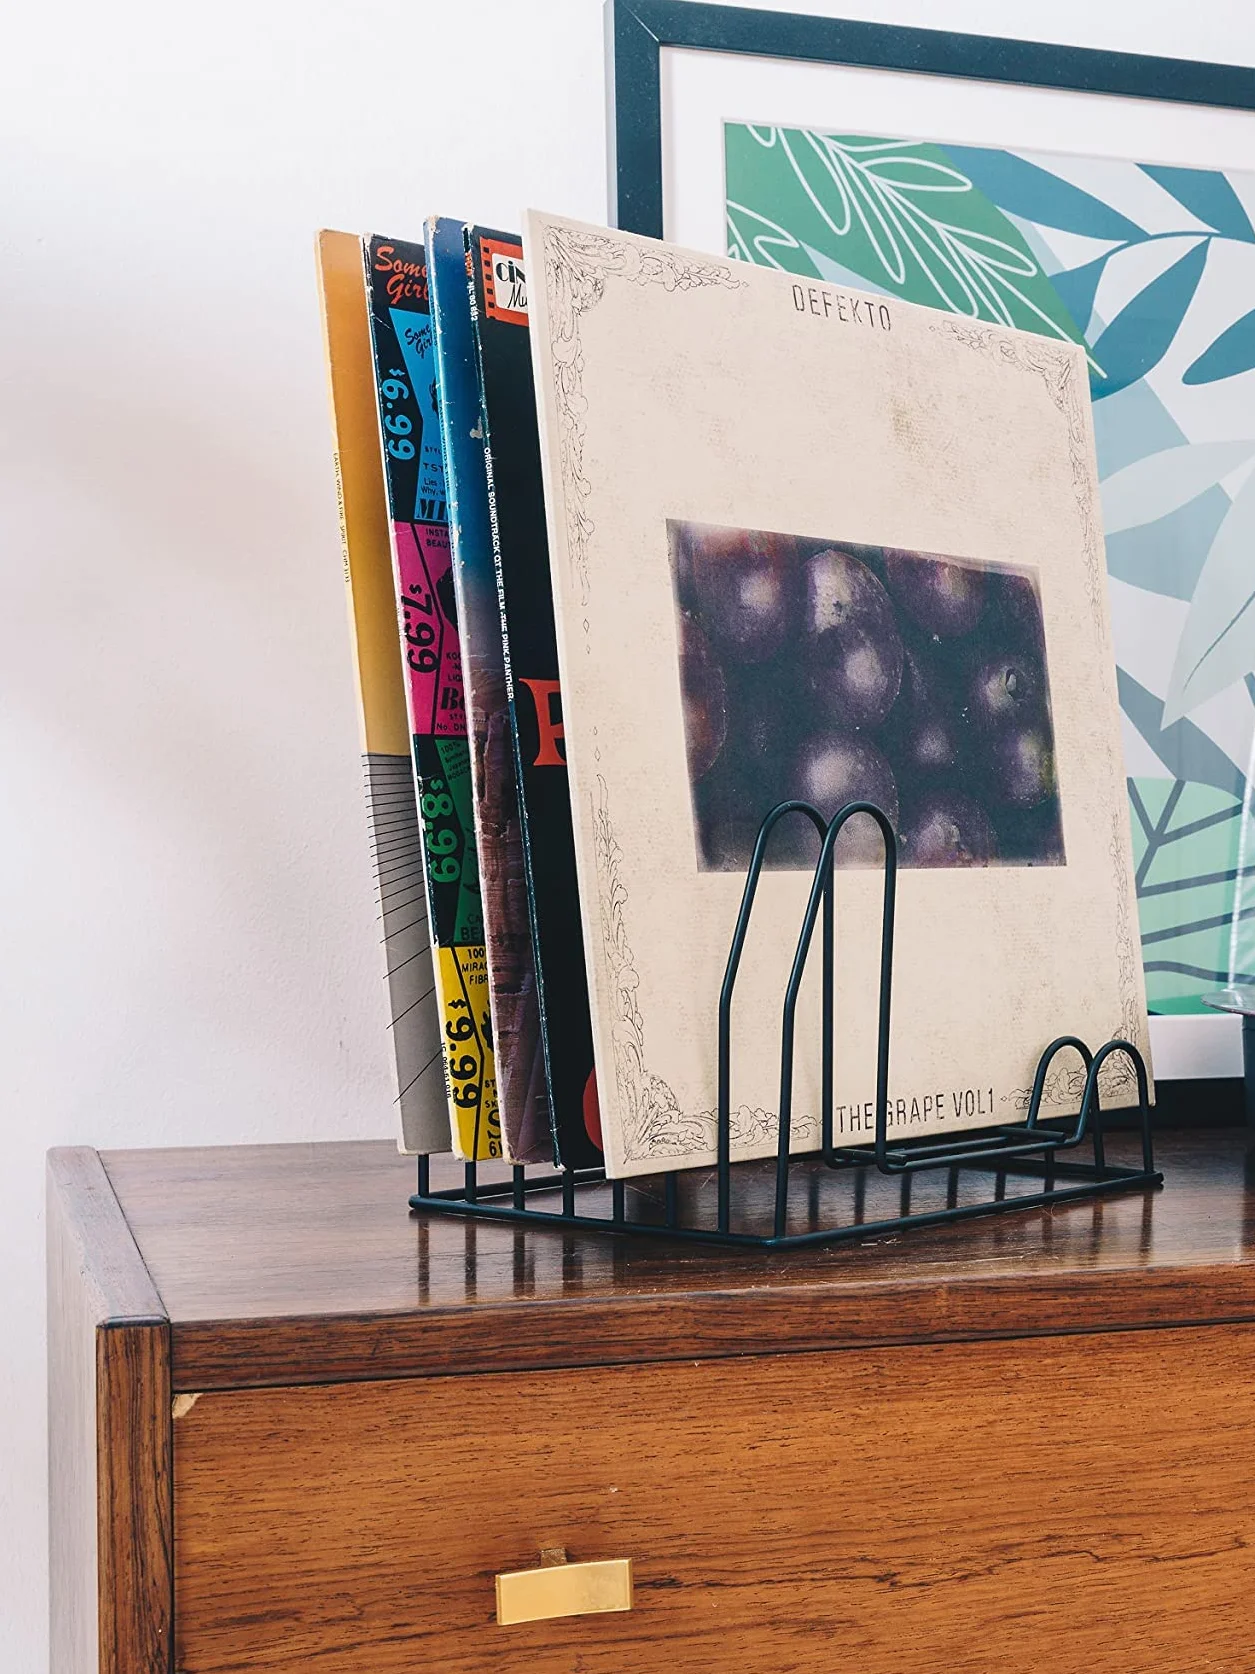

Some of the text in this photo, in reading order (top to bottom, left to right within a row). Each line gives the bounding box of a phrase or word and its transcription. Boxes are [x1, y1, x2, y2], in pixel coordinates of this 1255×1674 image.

[374, 245, 428, 278] Some
[791, 284, 892, 331] DEFEKTO
[483, 446, 495, 491] ORIGINAL
[488, 491, 501, 554] SOUNDTRACK
[836, 1102, 874, 1133] THE
[886, 1094, 945, 1127] GRAPE
